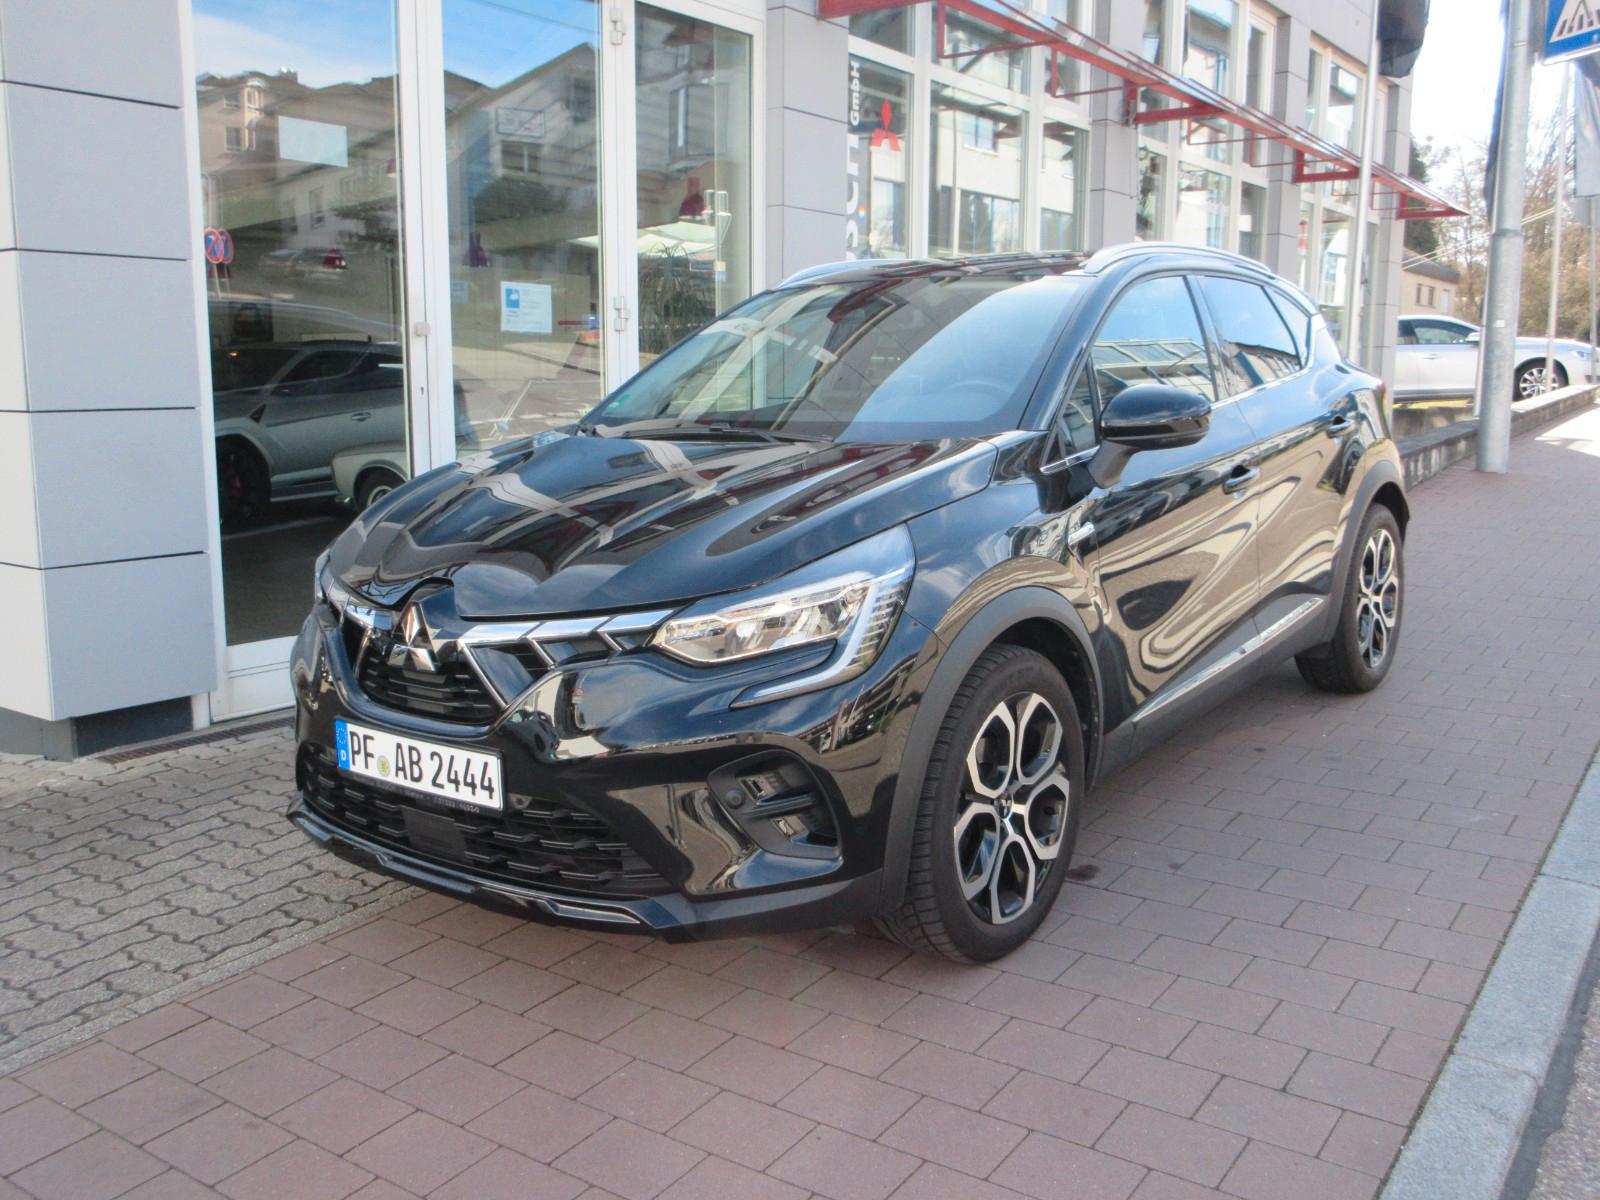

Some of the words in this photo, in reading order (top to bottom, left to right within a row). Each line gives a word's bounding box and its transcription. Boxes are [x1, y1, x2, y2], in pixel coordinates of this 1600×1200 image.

[850, 61, 860, 126] GmbH
[349, 730, 375, 770] PF
[395, 742, 423, 783] AB
[430, 751, 495, 800] 2444
